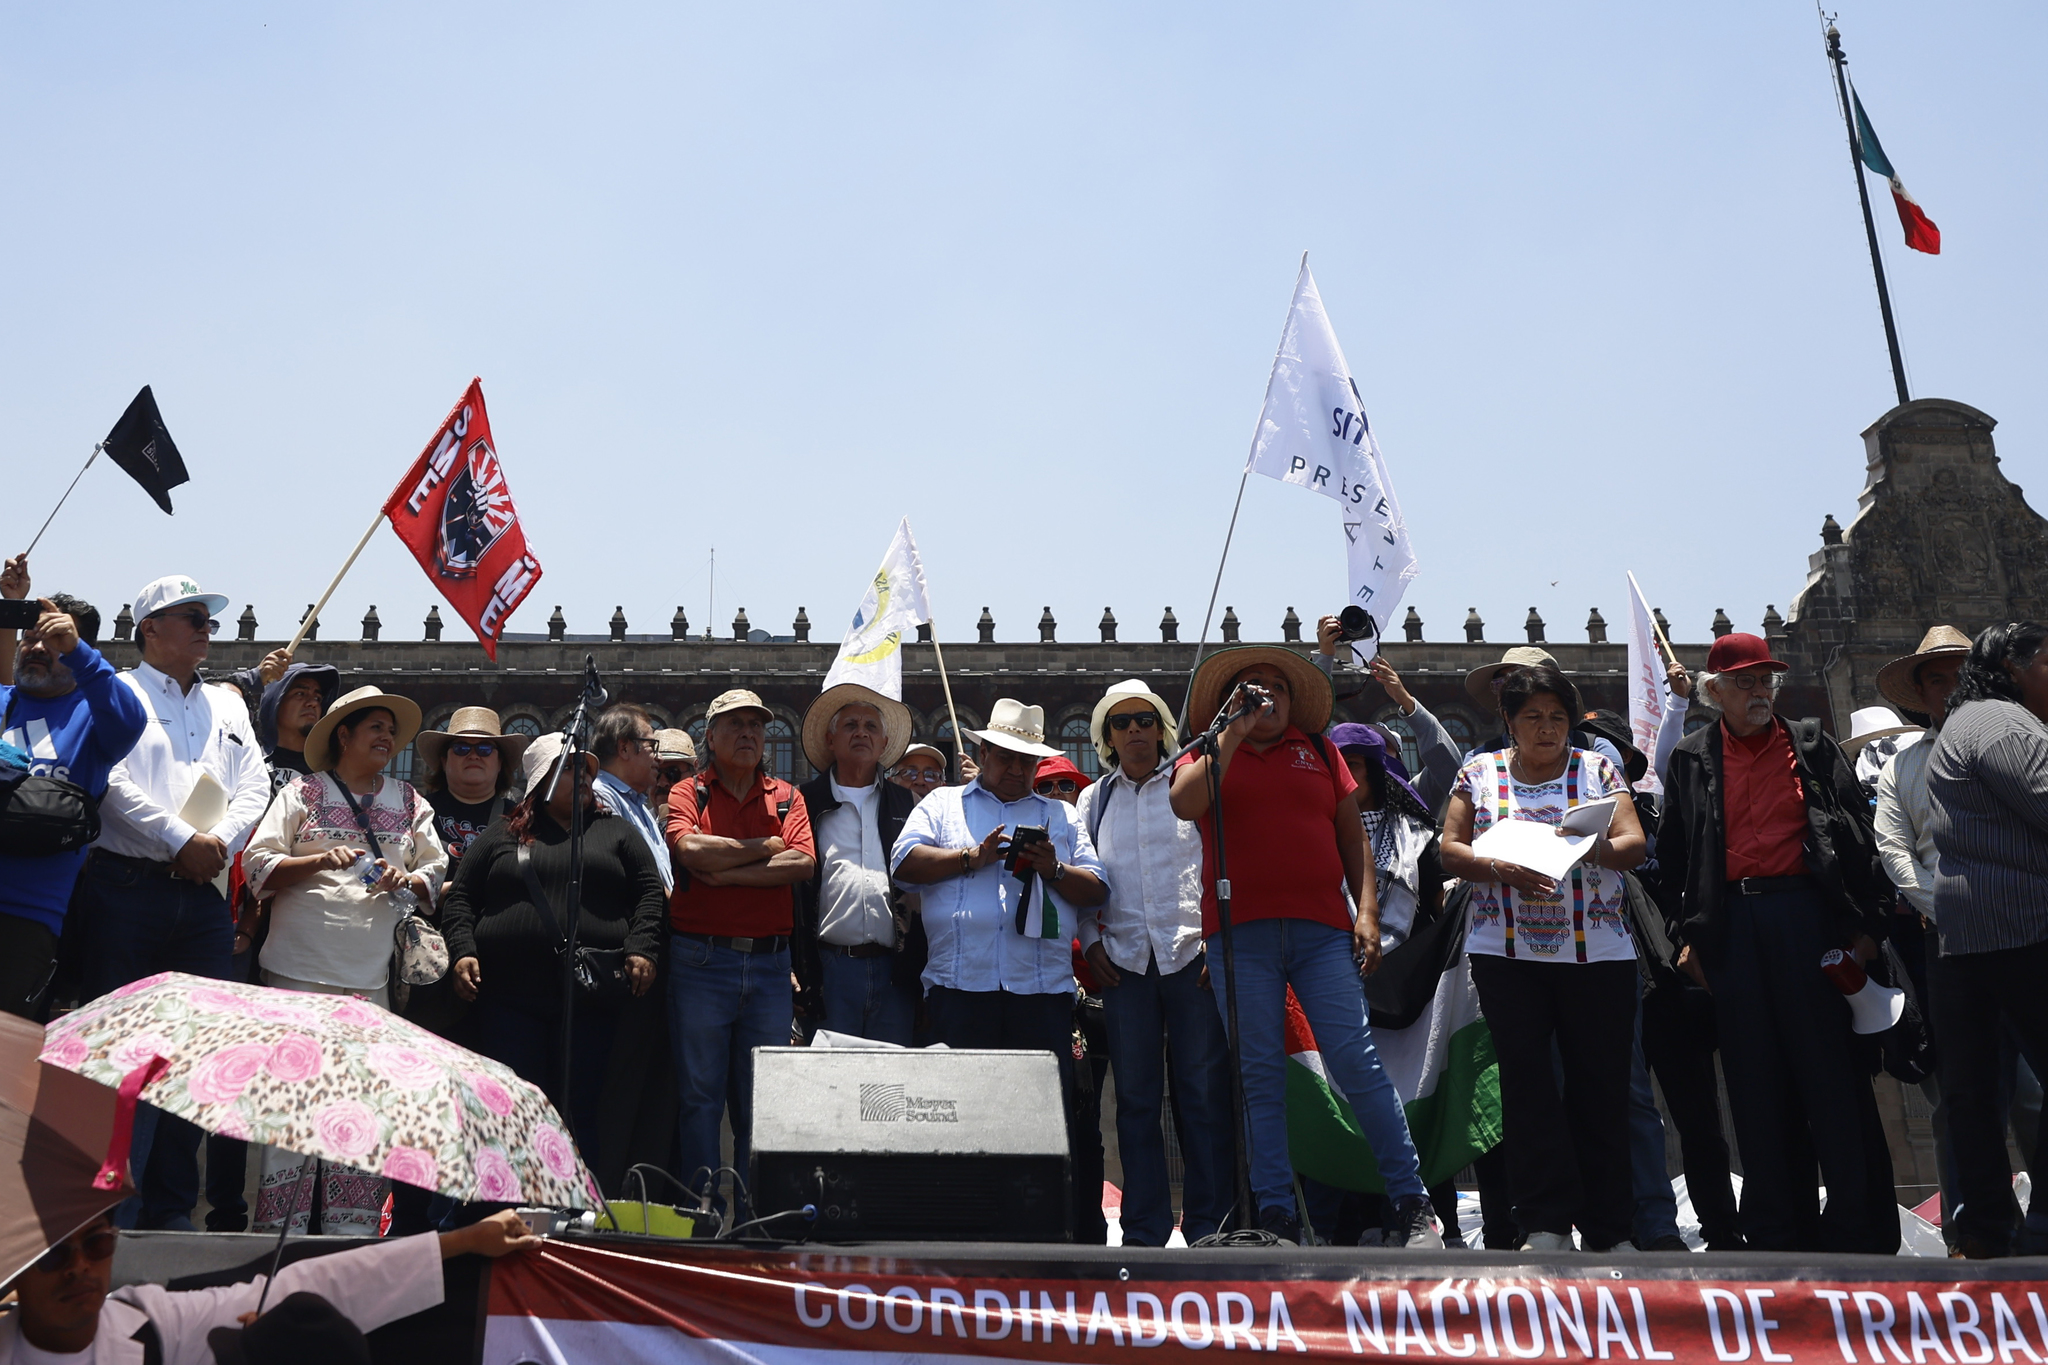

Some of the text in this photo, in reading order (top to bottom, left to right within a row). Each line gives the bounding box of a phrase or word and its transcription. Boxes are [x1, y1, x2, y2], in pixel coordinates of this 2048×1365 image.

[905, 1096, 957, 1111] Meyer
[905, 1110, 959, 1122] Sound
[794, 1281, 1307, 1352] COORDINADORA
[1342, 1286, 1675, 1360] NACIONAL
[1700, 1288, 1794, 1362] DE
